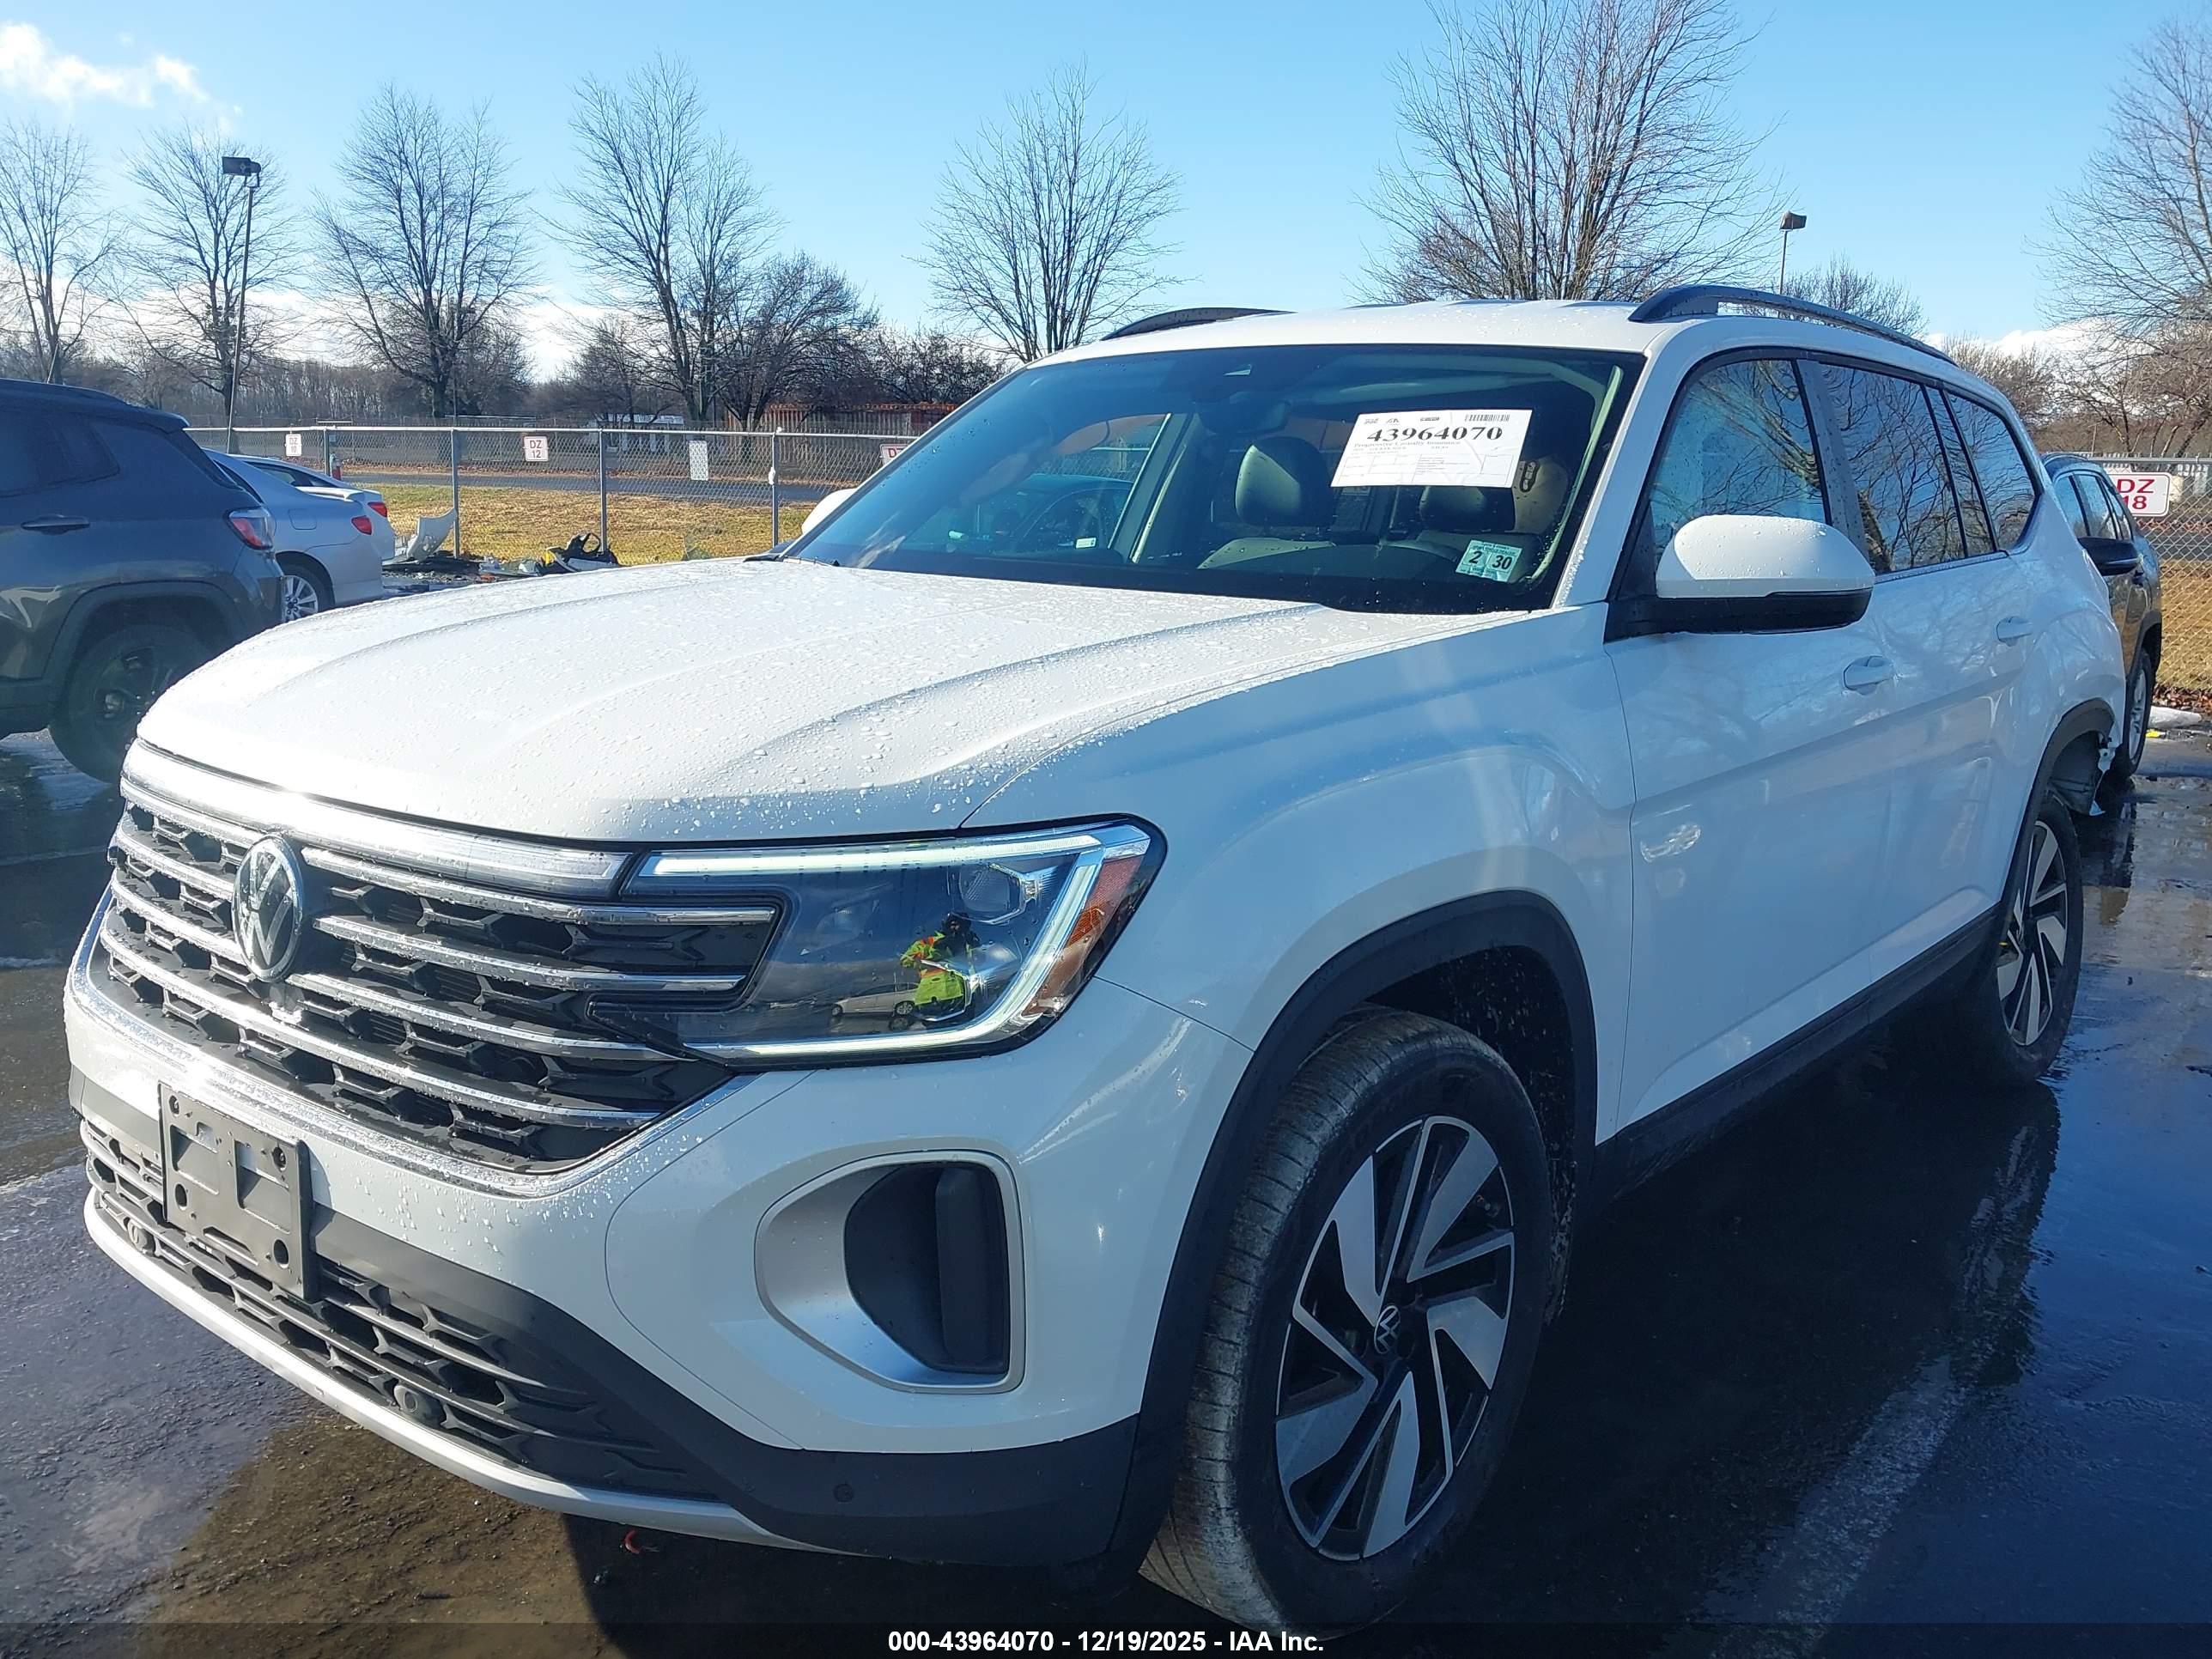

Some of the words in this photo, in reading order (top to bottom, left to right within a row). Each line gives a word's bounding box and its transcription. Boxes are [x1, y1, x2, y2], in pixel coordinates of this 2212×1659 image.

[1367, 426, 1503, 441] 43964070
[529, 440, 543, 449] DZ
[531, 449, 542, 459] 12
[2116, 478, 2155, 494] DZ
[1468, 550, 1483, 564] 2
[1492, 555, 1513, 570] 30
